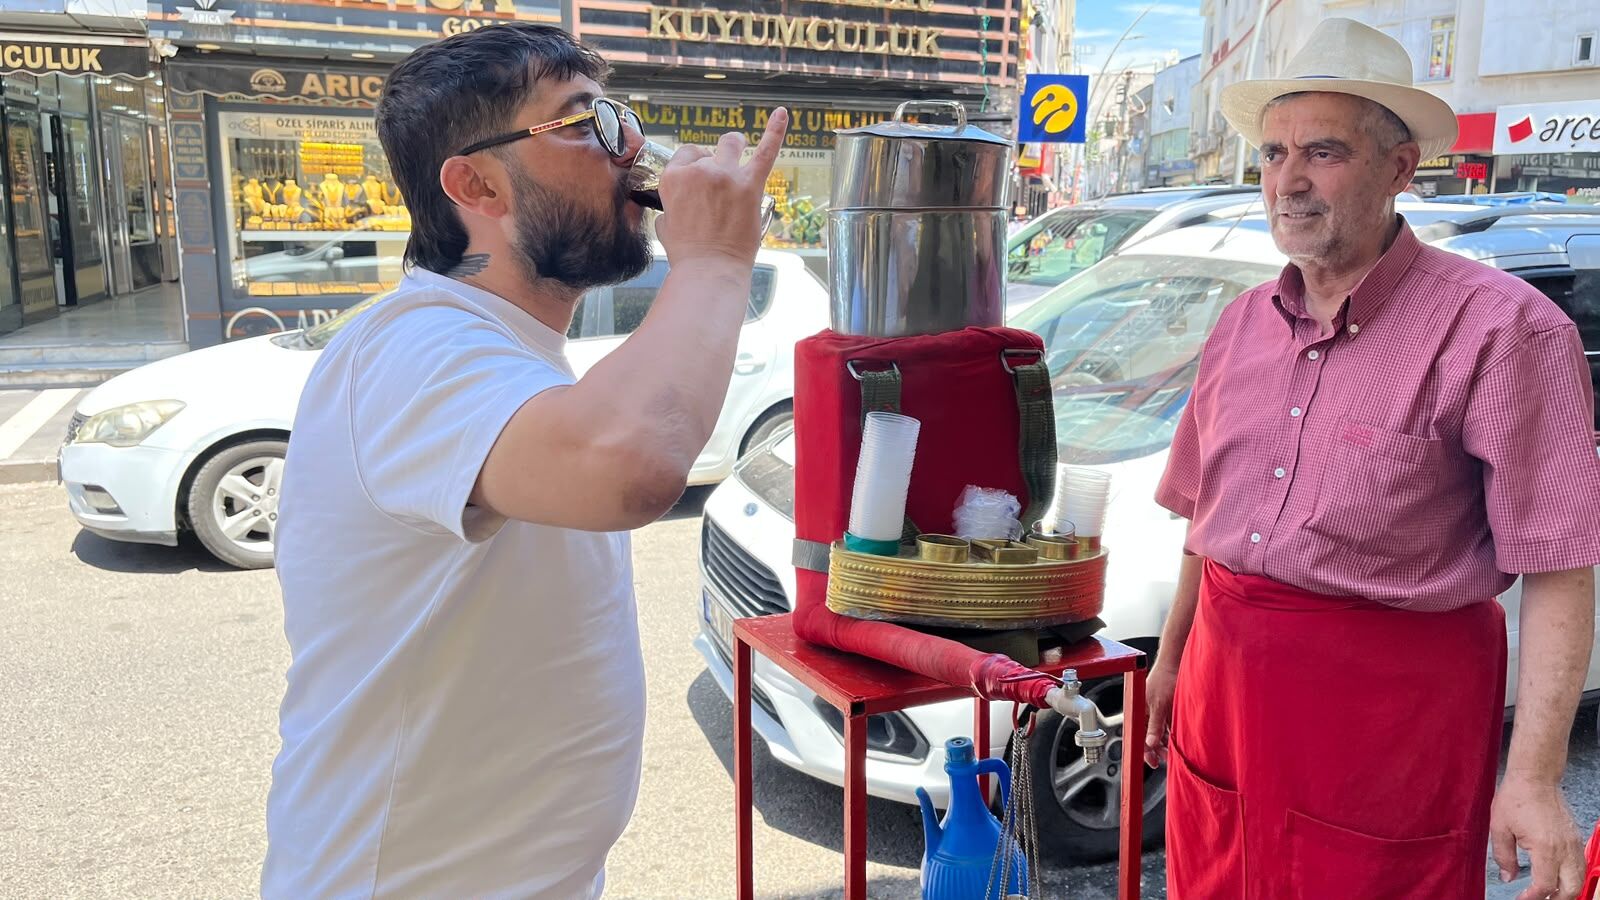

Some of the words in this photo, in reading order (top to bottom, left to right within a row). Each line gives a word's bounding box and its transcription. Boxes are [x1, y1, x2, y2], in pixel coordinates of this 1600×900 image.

[442, 17, 514, 41] GO
[647, 6, 944, 58] KUYUMCULUK
[0, 45, 102, 72] CULUK
[276, 117, 303, 128] ÖZEL
[680, 130, 720, 144] Mehm
[744, 133, 762, 146] AC
[786, 135, 817, 147] 0536
[789, 150, 826, 160] ALINIR
